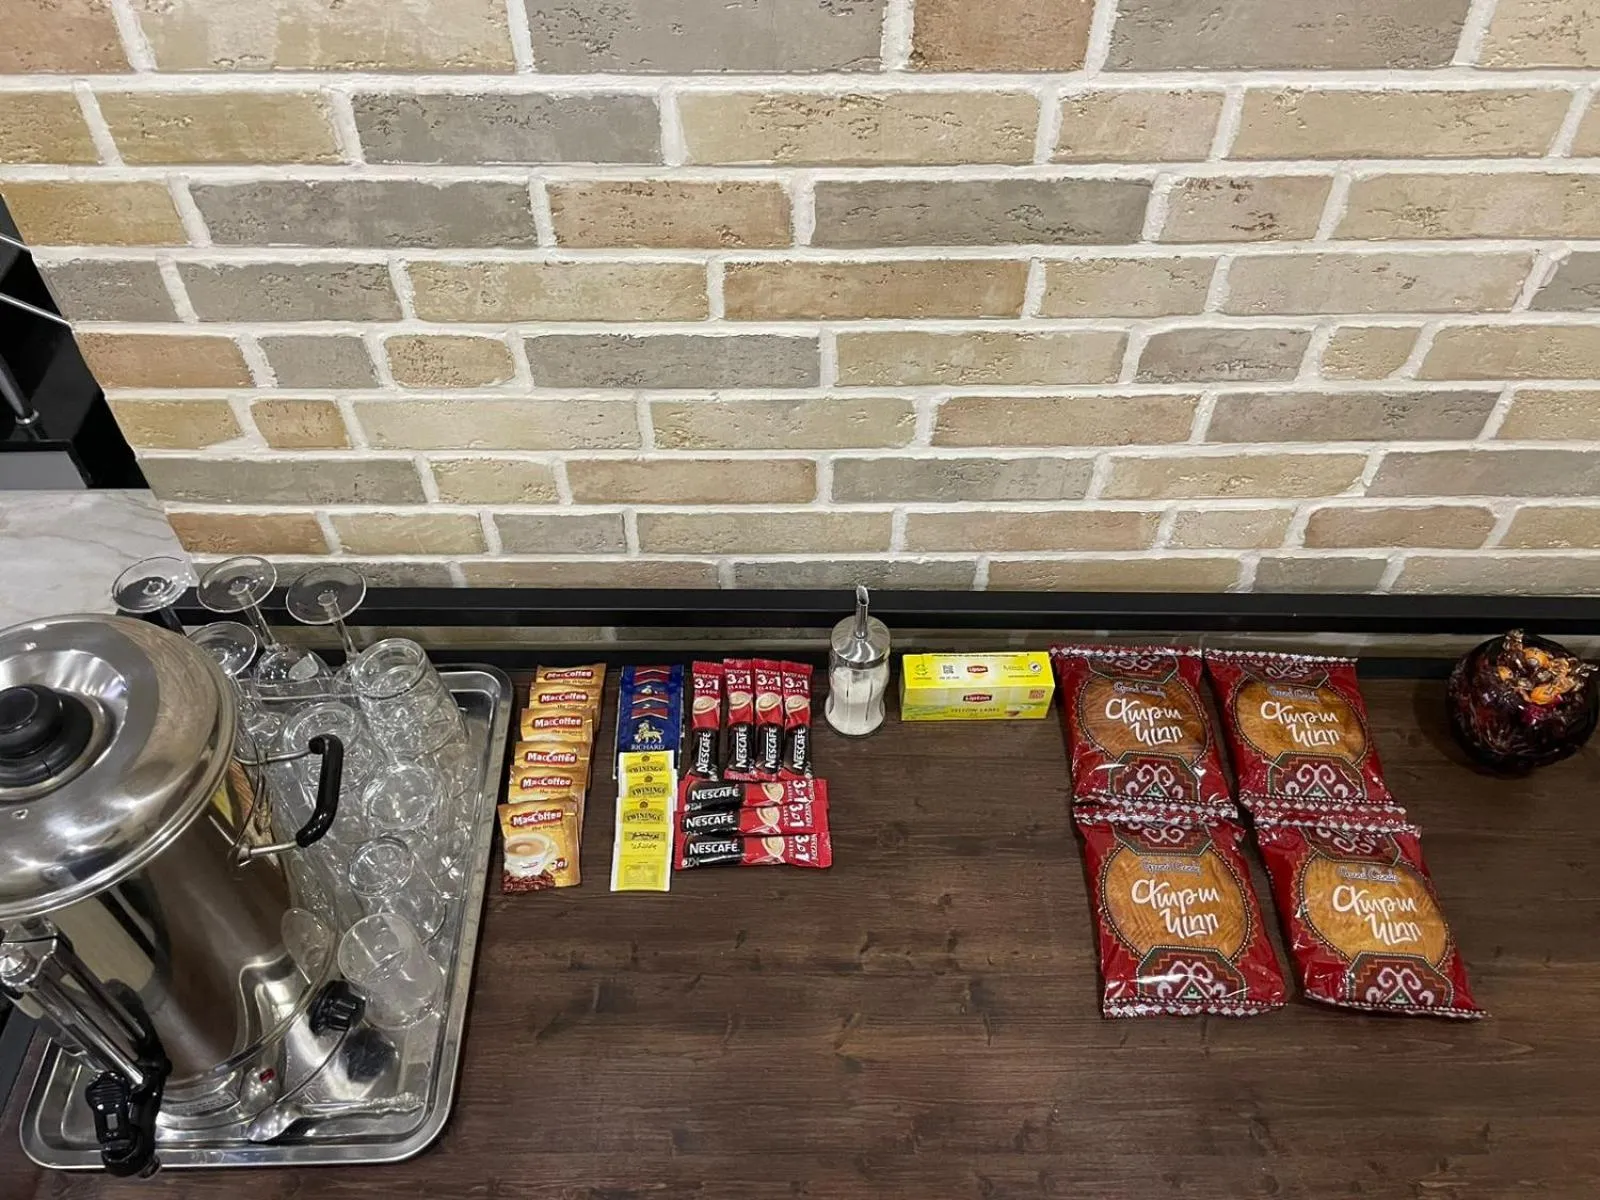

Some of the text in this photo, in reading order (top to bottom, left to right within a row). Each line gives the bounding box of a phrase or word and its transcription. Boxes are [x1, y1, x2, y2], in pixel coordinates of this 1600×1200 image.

[541, 692, 587, 703] MacCoffee
[965, 694, 991, 702] Lipton
[534, 717, 581, 728] MacCoffee
[631, 743, 666, 751] RICHARD
[527, 751, 576, 763] MacCoffee
[522, 777, 572, 789] MacCoffee
[632, 783, 666, 796] TWININGS
[513, 811, 562, 826] MacCoffee
